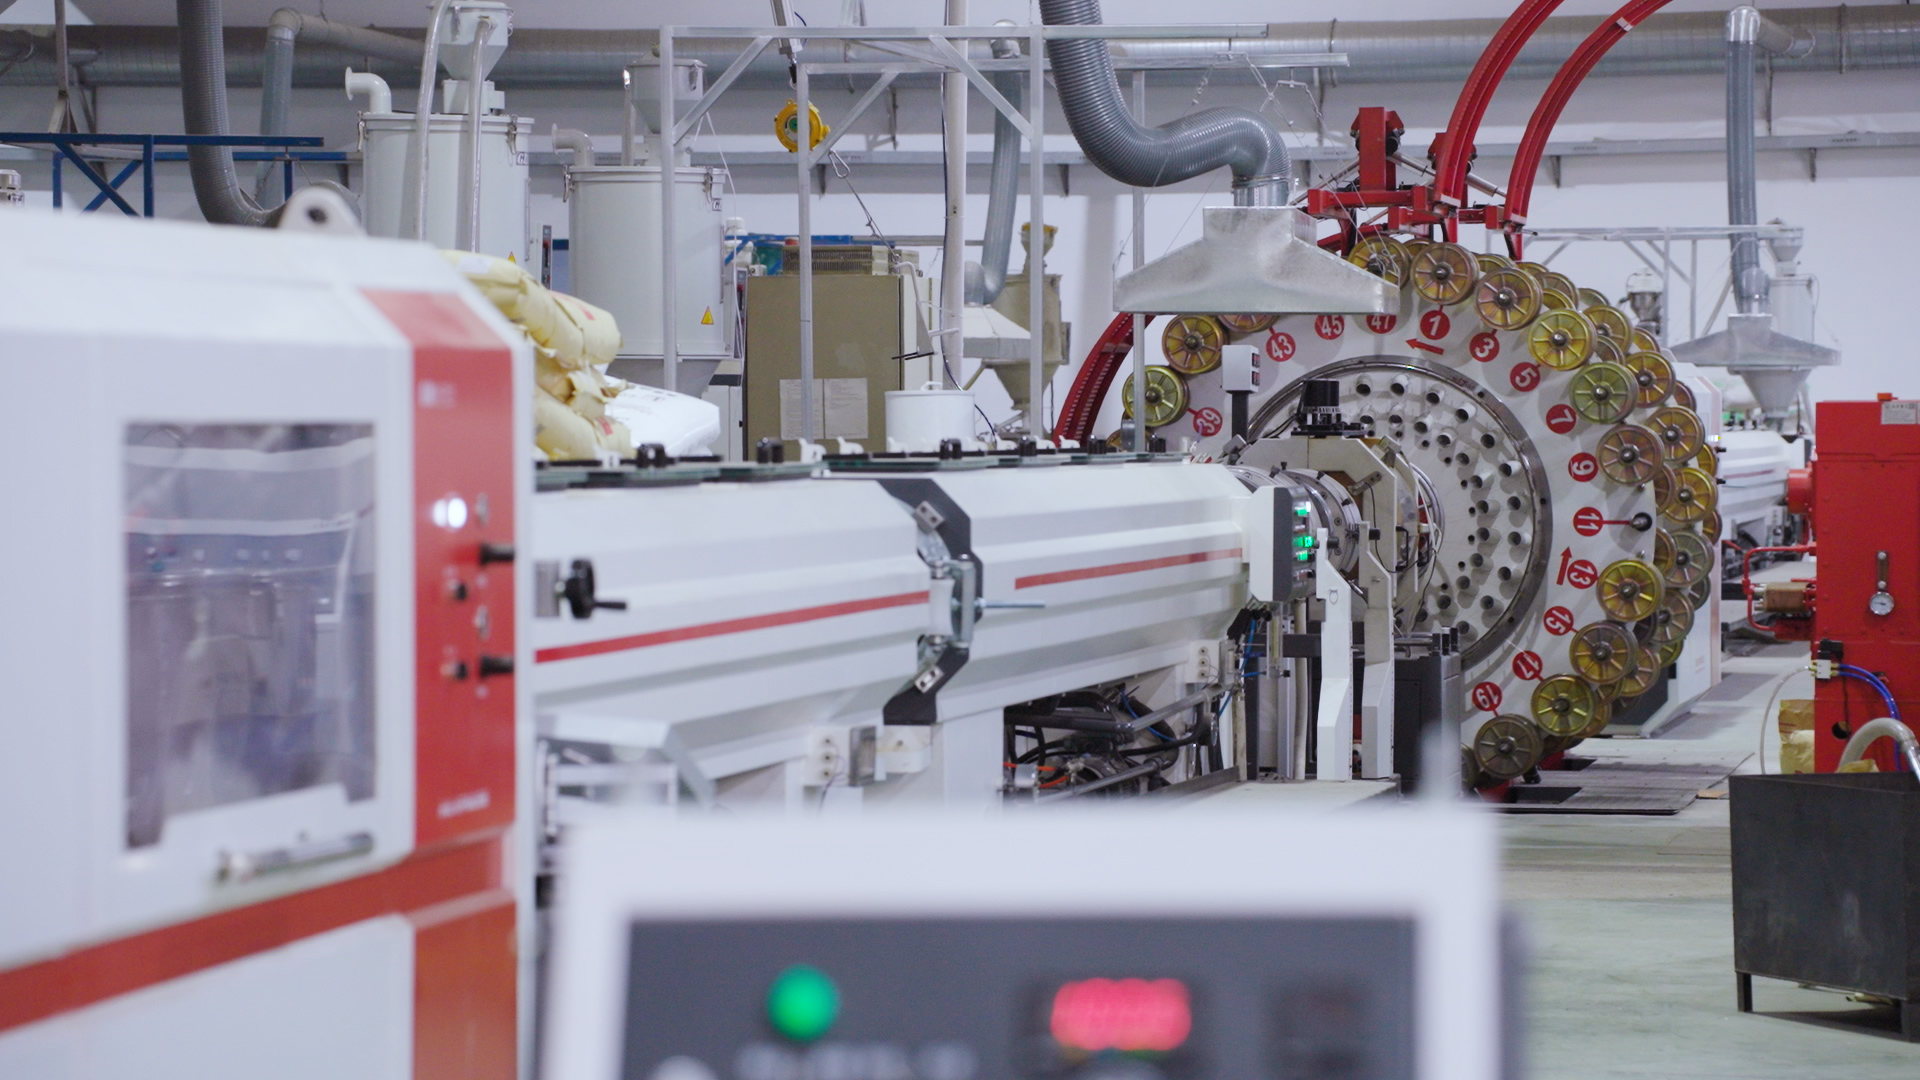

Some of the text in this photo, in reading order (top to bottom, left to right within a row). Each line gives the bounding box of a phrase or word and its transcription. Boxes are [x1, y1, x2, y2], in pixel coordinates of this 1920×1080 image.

[1322, 315, 1342, 336] 45
[1371, 314, 1391, 330] 47
[1429, 315, 1441, 336] 1
[1271, 336, 1294, 359] 43
[1475, 338, 1495, 358] 3
[1515, 368, 1537, 387] 5
[1197, 409, 1221, 434] 39
[1550, 409, 1574, 425] 7
[1572, 460, 1595, 475] 9
[1577, 512, 1600, 531] 11
[1569, 563, 1595, 585] 13
[1545, 609, 1571, 633] 15
[1519, 652, 1540, 678] 17
[1475, 684, 1499, 708] 19
